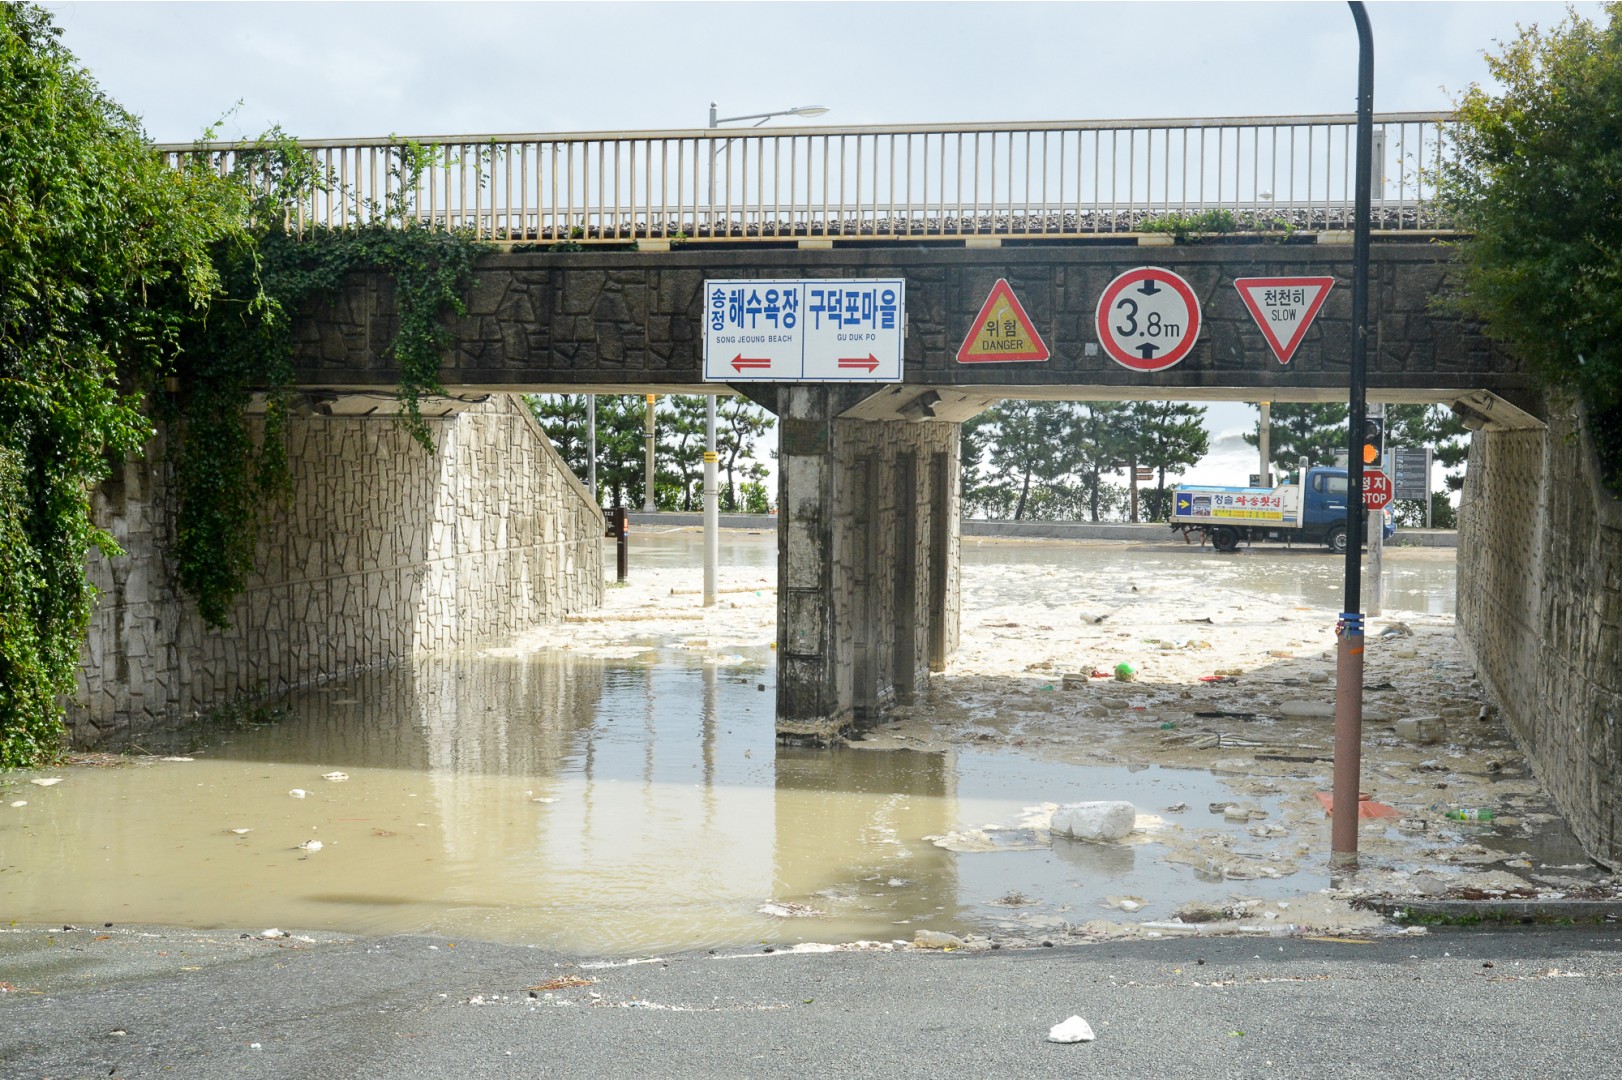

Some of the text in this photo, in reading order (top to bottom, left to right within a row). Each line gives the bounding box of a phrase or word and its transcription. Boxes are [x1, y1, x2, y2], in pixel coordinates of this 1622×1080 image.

[1264, 288, 1305, 306] 천천히
[711, 288, 799, 331] 송정 해수욕장
[809, 289, 897, 330] 구덕포마을
[1116, 298, 1180, 337] 3.8m
[1271, 309, 1296, 321] SLOW
[865, 333, 876, 341] PO
[986, 320, 1016, 337] 위험
[738, 335, 765, 343] JEOUNG
[982, 340, 1023, 350] DANGER
